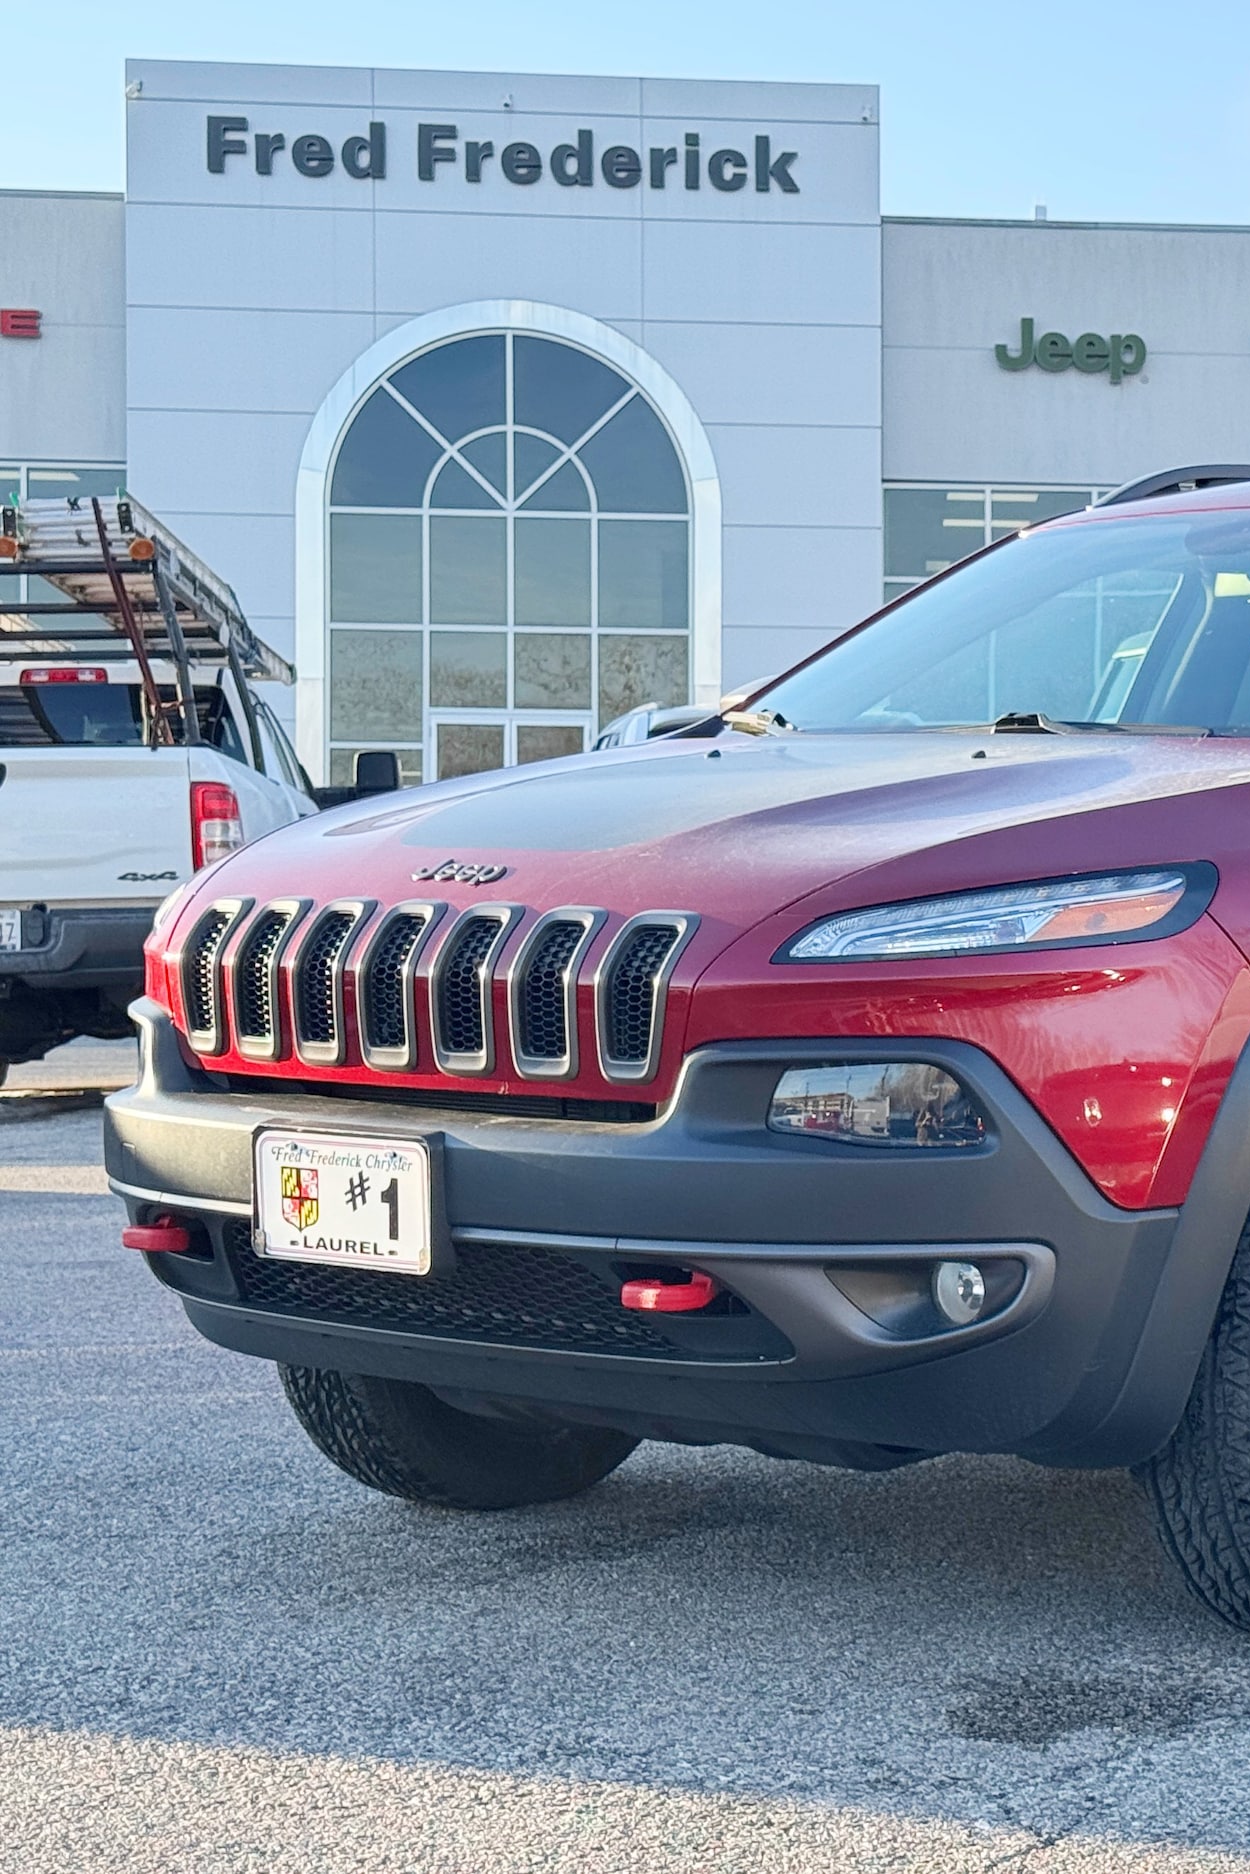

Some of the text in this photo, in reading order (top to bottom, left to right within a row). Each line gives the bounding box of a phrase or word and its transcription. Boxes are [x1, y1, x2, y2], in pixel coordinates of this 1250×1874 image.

[206, 115, 801, 194] Fred Frederick
[995, 317, 1148, 384] Jeep
[411, 859, 508, 887] Jeep
[271, 1146, 413, 1173] Fred Frederick Chrysler
[303, 1235, 385, 1256] LAUREL
